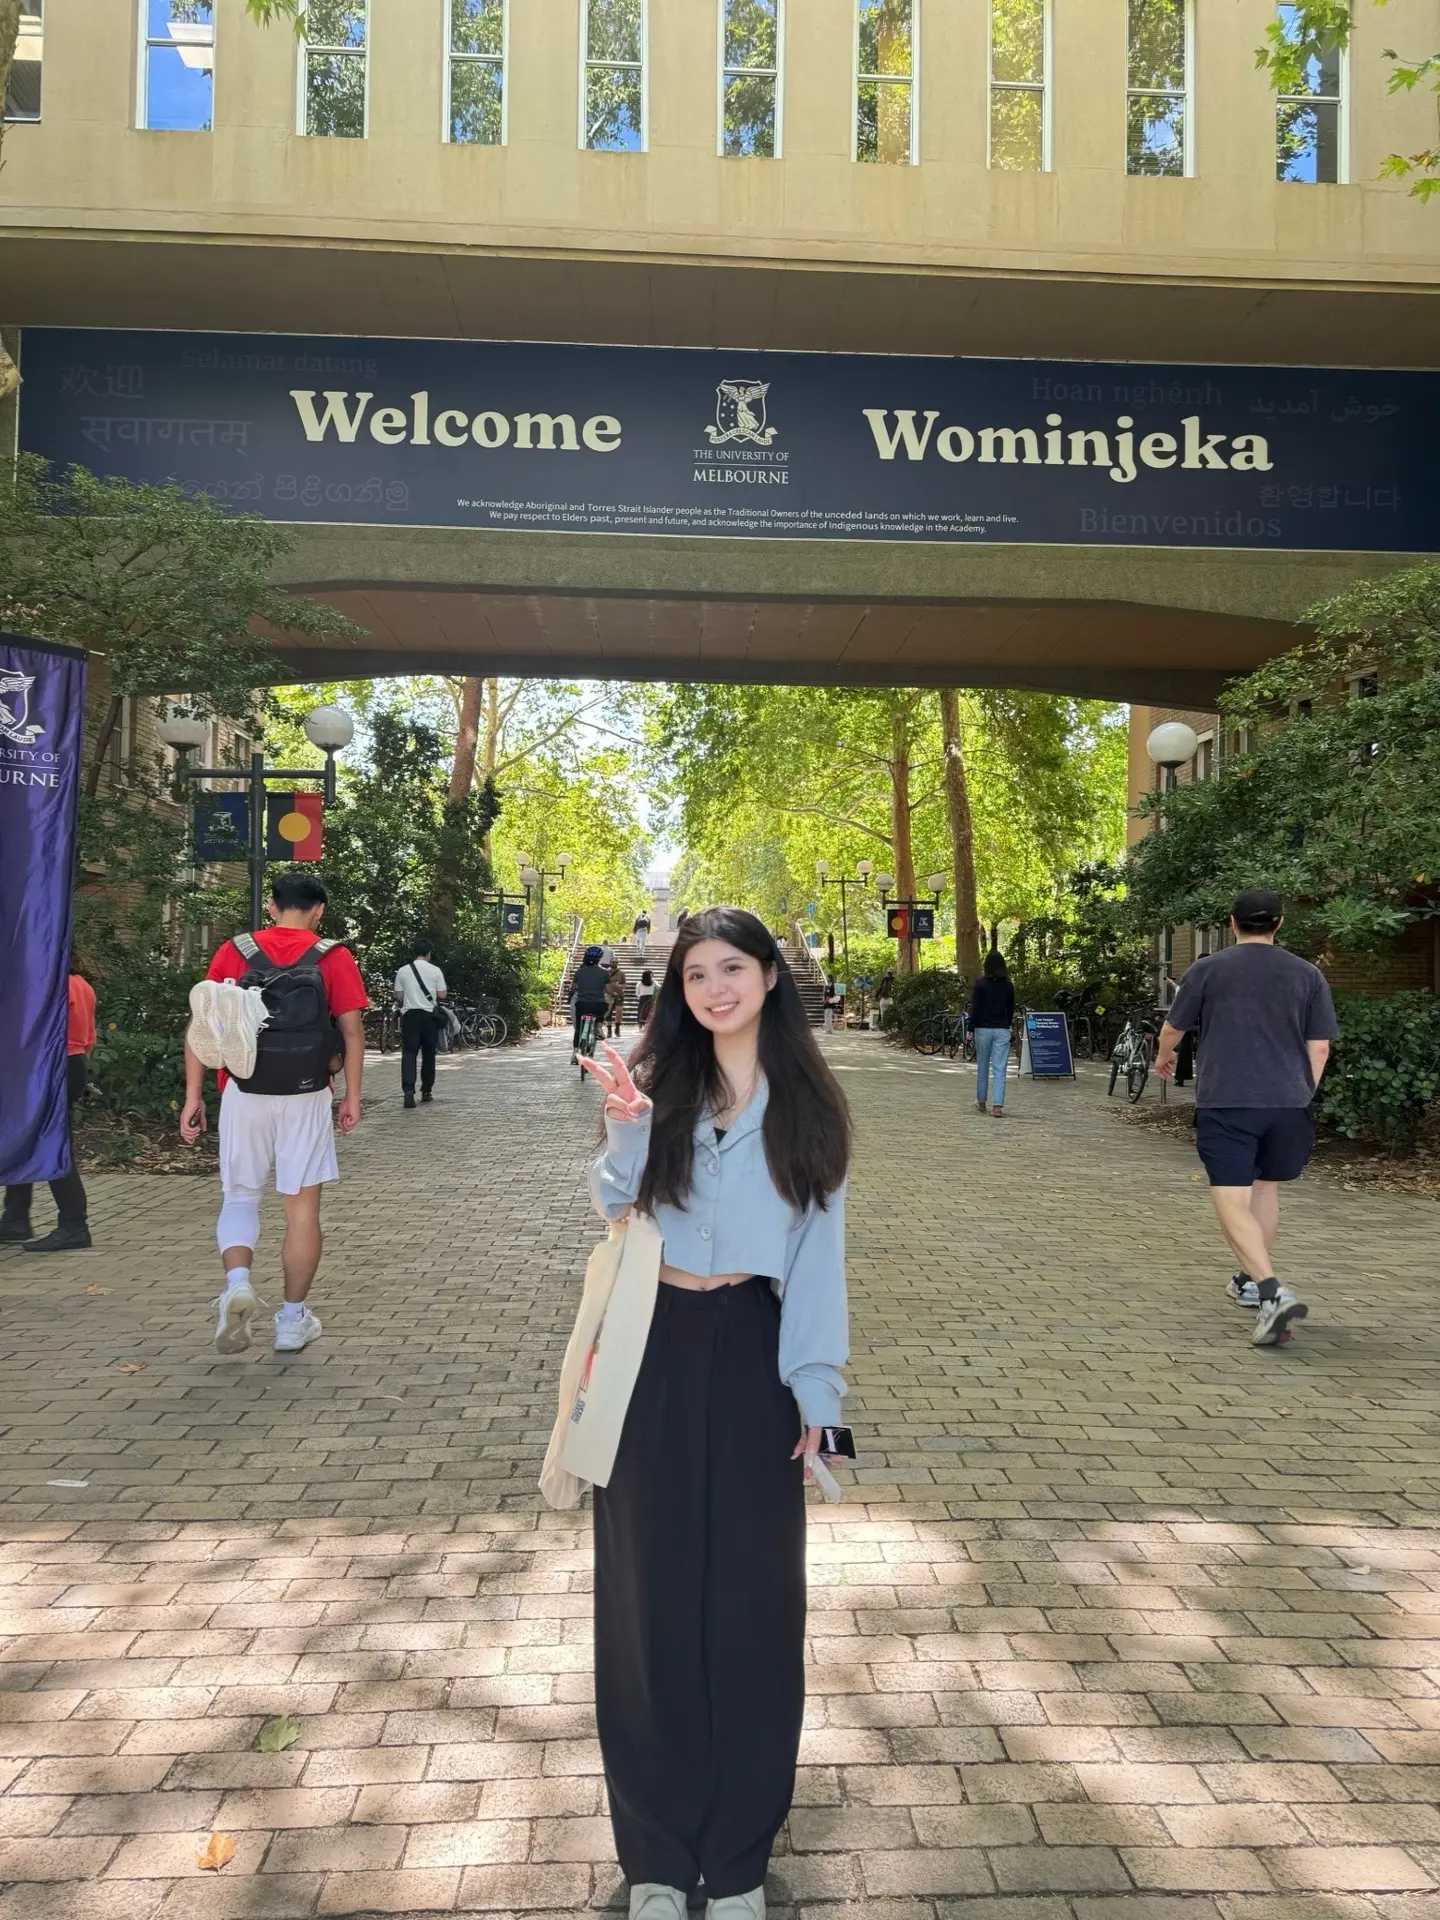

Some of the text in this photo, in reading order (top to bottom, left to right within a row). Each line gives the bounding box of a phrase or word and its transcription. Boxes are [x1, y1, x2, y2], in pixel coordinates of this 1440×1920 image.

[181, 348, 378, 380] Selamat datang
[58, 364, 145, 398] 欢迎
[1031, 378, 1222, 409] Hoan nghênh
[290, 390, 622, 452] Welcome
[693, 449, 789, 462] THE UNIVERSITY OF
[862, 409, 1274, 483] Wominjeka
[693, 469, 789, 485] MELBOURNE
[457, 498, 470, 507] We
[471, 499, 524, 511] acknowledge
[525, 501, 568, 511] Aboriginal
[569, 503, 585, 511] and
[587, 503, 616, 512] Torres
[618, 504, 642, 513] Strait
[643, 505, 673, 514] Islander
[675, 507, 702, 516] people
[713, 508, 726, 516] the
[728, 508, 769, 517] Traditional
[770, 509, 799, 518] Owners
[801, 510, 809, 518] of
[810, 510, 823, 519] the
[824, 511, 863, 519] unceded
[864, 511, 888, 520] lands
[902, 512, 926, 520] which
[941, 513, 963, 522] work,
[964, 513, 984, 522] learn
[986, 514, 1001, 522] and
[1002, 515, 1019, 523] live.
[1258, 483, 1402, 511] 환영합니다
[489, 510, 987, 534] We pay respect to Elders past, present and future, and acknowledge the importance of Indigenous knowledge in the Academy.
[1078, 507, 1282, 537] Bienvenidos
[41, 752, 60, 763] OF
